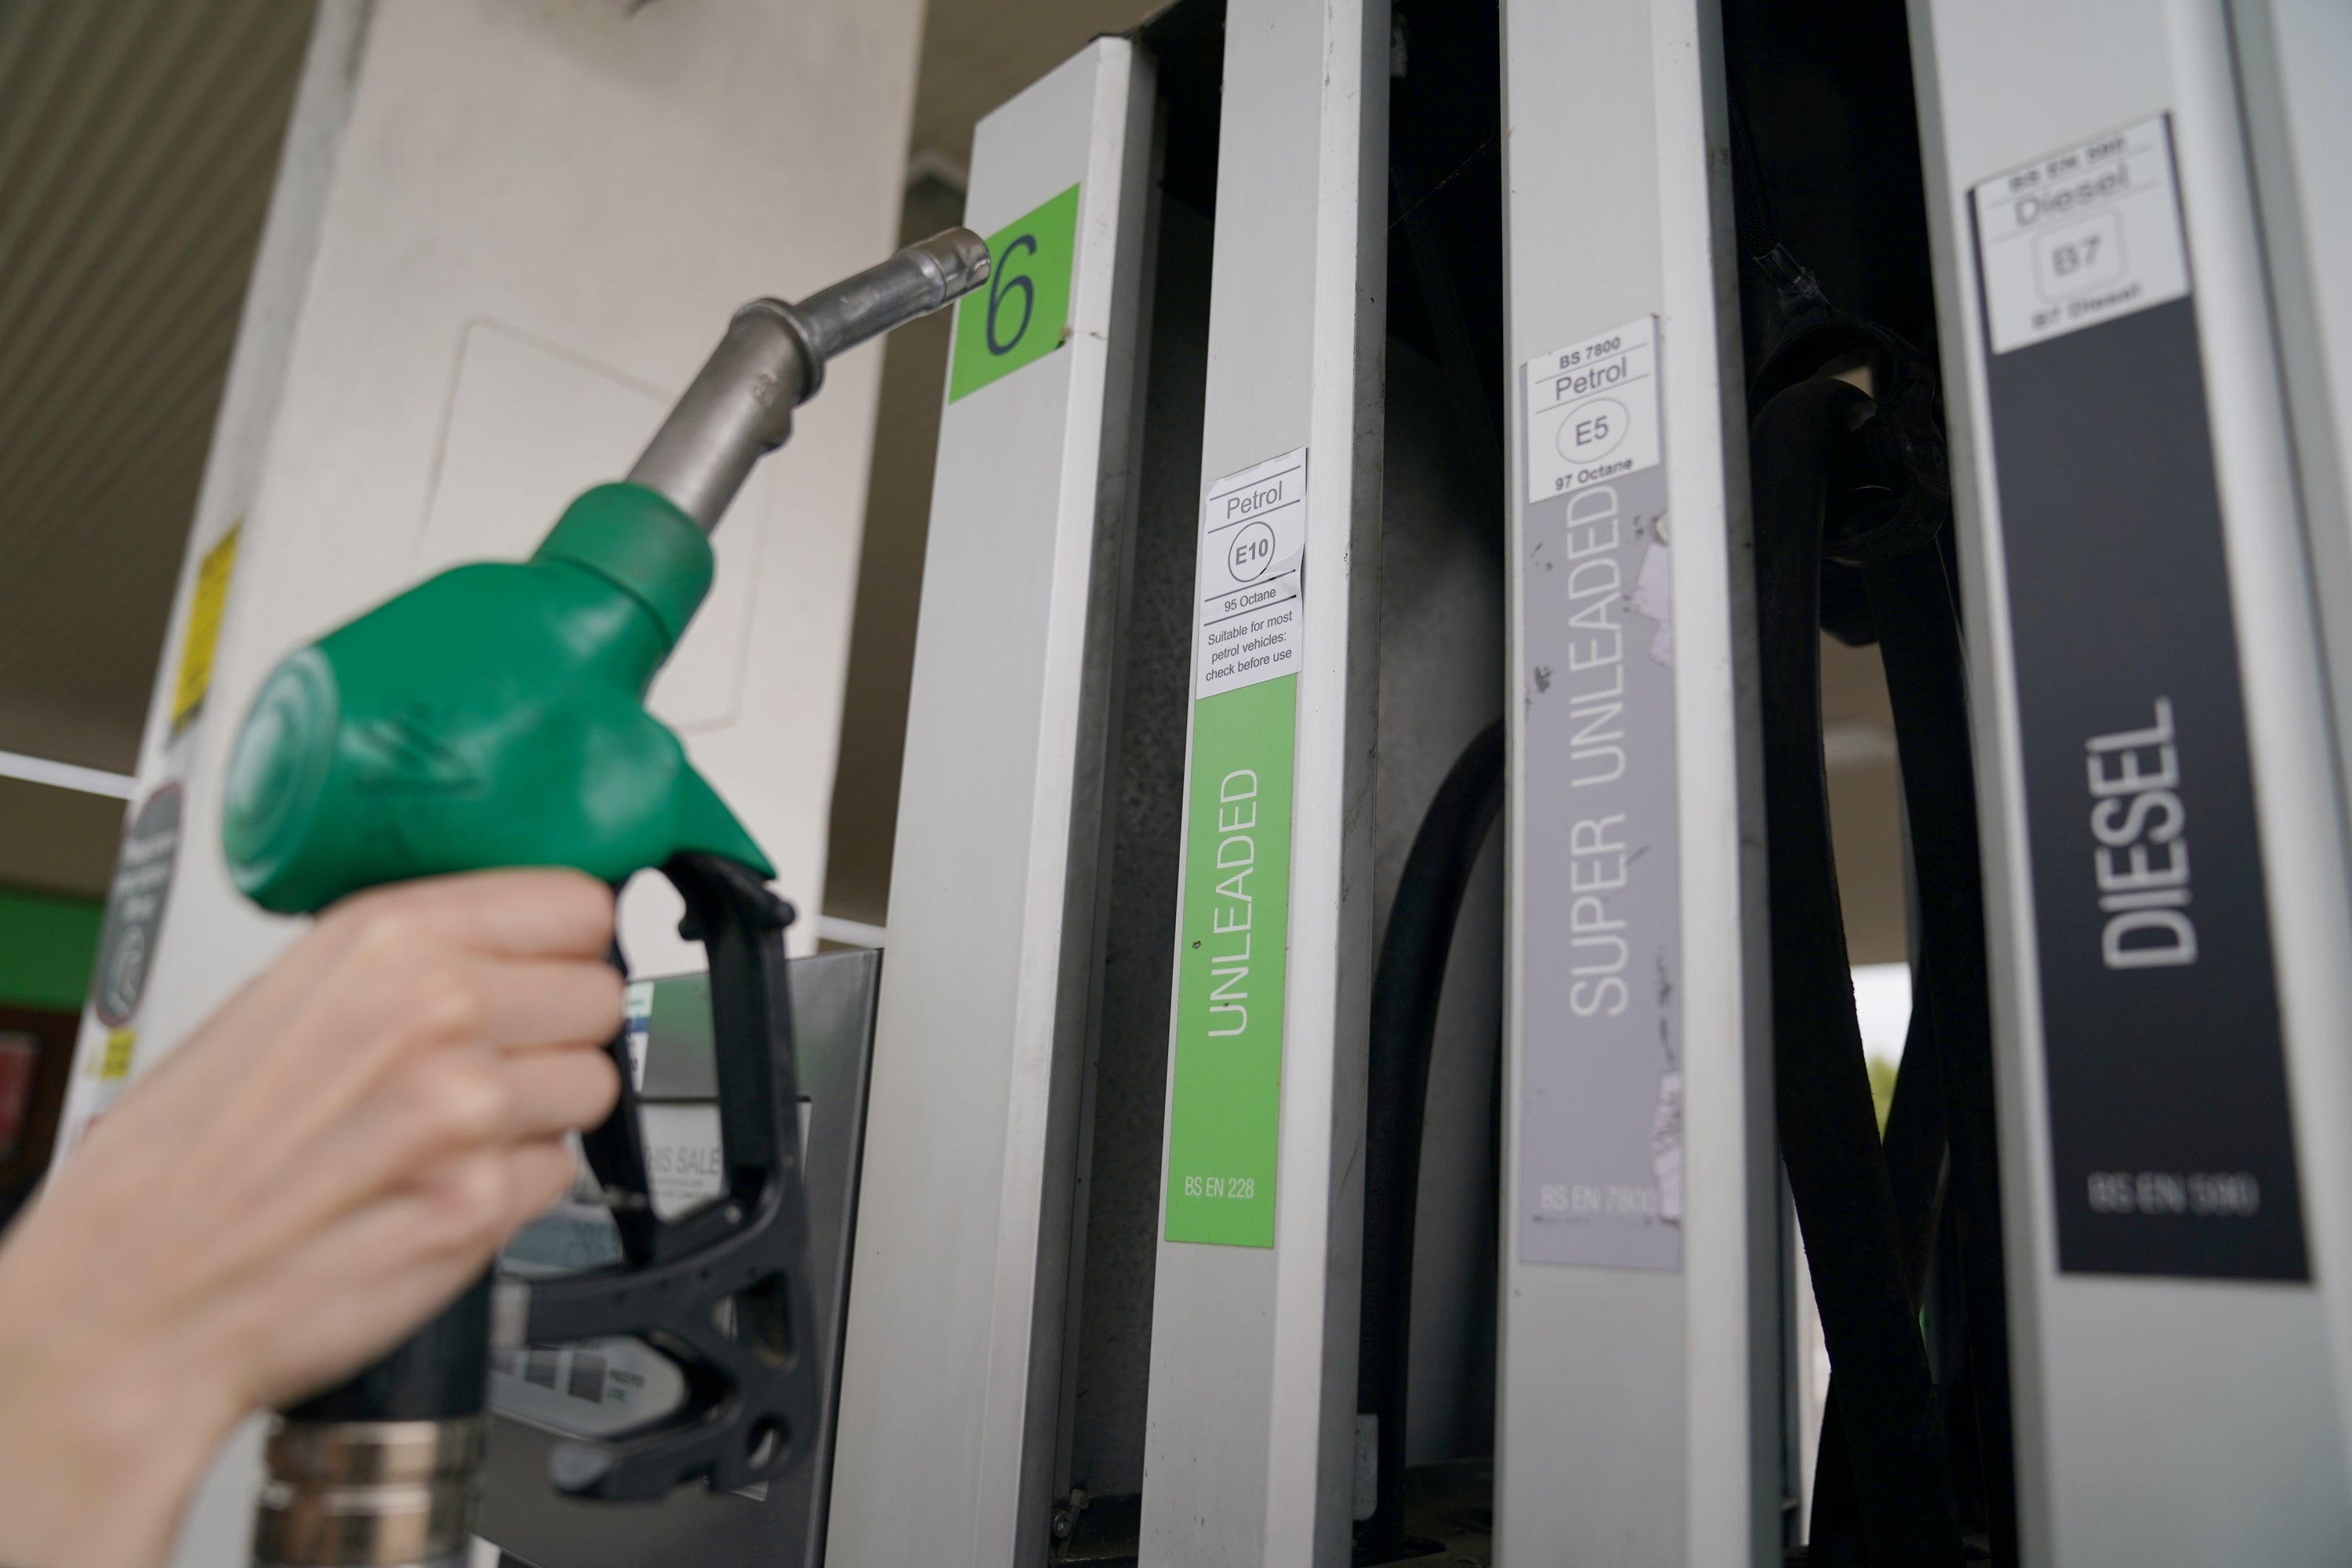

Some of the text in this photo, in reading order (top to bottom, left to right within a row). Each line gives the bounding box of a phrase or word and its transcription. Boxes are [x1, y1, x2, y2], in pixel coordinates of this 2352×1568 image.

[2014, 164, 2130, 227] Diesel
[2052, 234, 2100, 276] B7
[985, 234, 1037, 357] 6
[1559, 336, 1621, 369] BS 7800
[1555, 355, 1627, 401] Petrol
[1575, 416, 1610, 446] E5
[1555, 459, 1633, 492] 97 Octane
[1226, 480, 1283, 519] Petrol
[1235, 538, 1269, 565] E10
[1224, 588, 1276, 612] 95 Octane
[1208, 610, 1293, 645] Suitable for most
[1211, 632, 1287, 664] petrol vehicles:
[1206, 649, 1292, 681] check before use
[1566, 485, 1630, 1018] SUPER UNLEADED
[2085, 695, 2198, 970] DIESEL
[1208, 768, 1258, 1037] UNLEADED
[676, 1146, 721, 1174] SALE
[1185, 1176, 1254, 1199] BS EN 228
[1541, 1184, 1567, 1212] BS
[1571, 1185, 1601, 1213] EN
